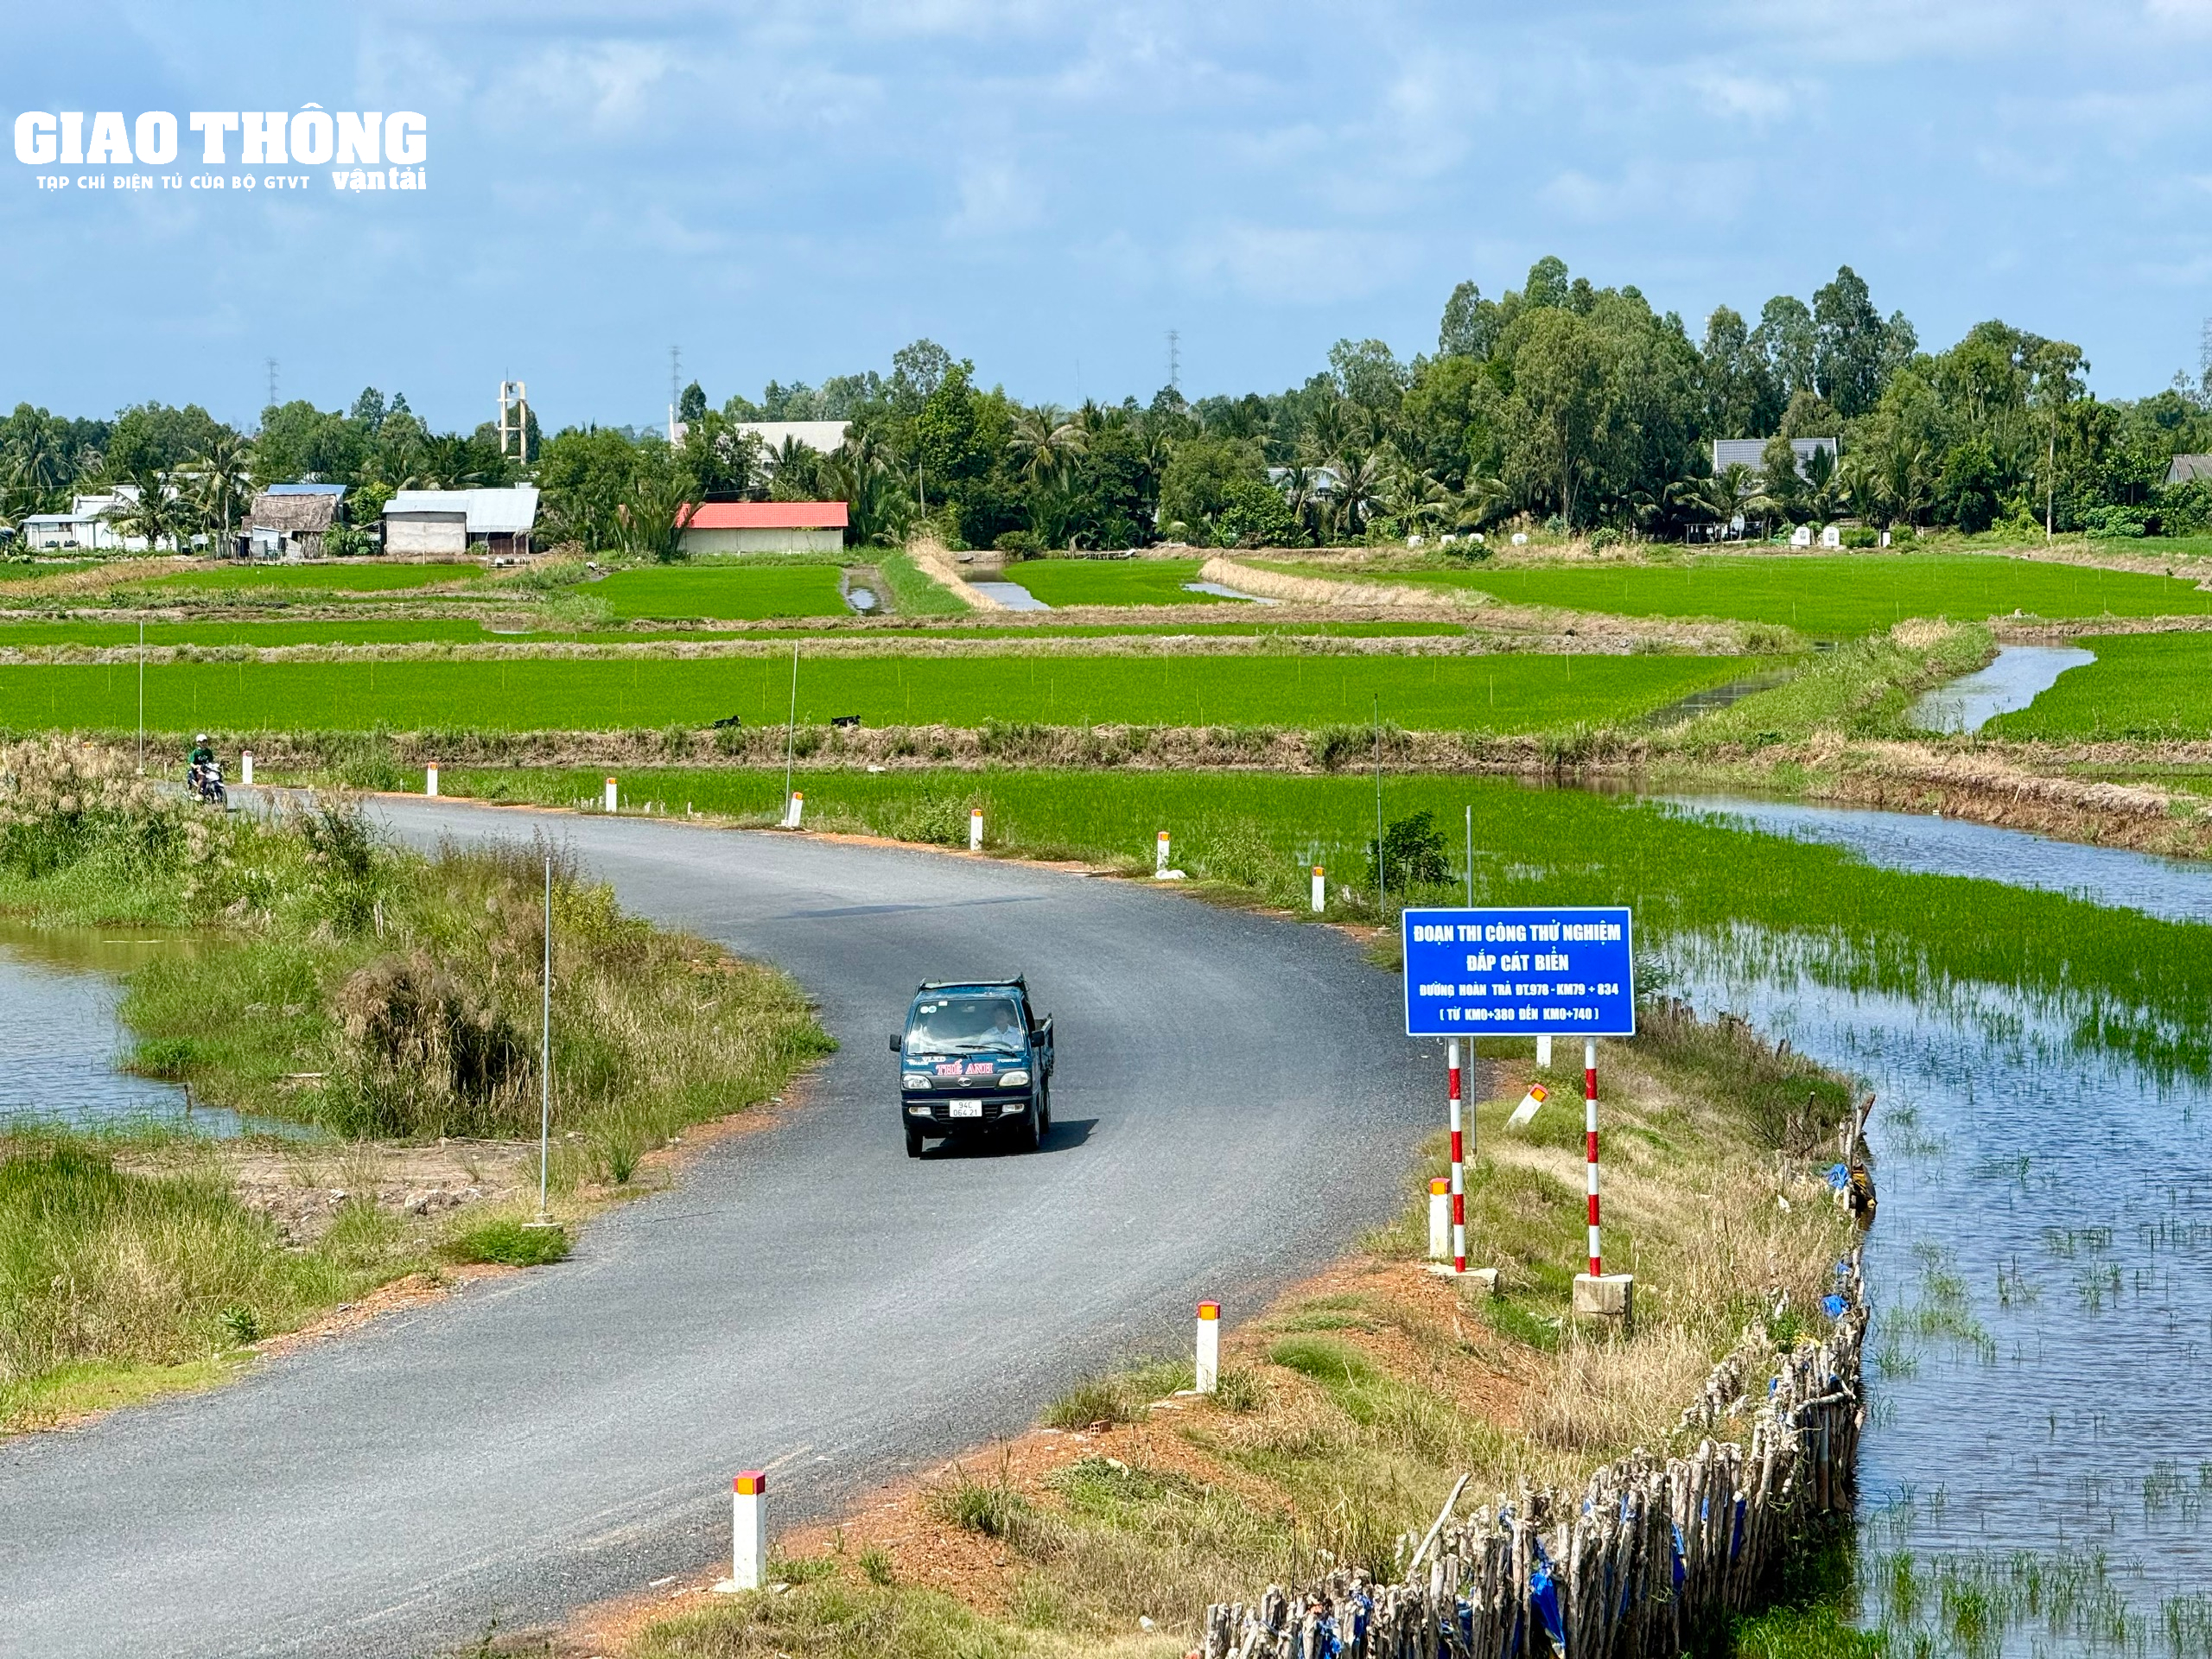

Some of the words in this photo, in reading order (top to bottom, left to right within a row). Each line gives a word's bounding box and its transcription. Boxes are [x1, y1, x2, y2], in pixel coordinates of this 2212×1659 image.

[1414, 925, 1454, 946] ĐOẠN
[1457, 925, 1483, 942] THI
[1484, 921, 1527, 943] CÔNG
[1529, 918, 1561, 942] THỬ
[1562, 919, 1621, 946] NGHIỆM
[1466, 948, 1497, 972] ĐẮP
[1500, 950, 1530, 972] CÁT
[1535, 945, 1569, 971] BIỂN
[1419, 981, 1455, 996] ĐƯỜNG
[1459, 981, 1487, 996] HOÀN
[1491, 980, 1513, 996] TRẢ
[1556, 983, 1586, 995] KM79
[1597, 982, 1619, 995] 834
[1518, 1003, 1539, 1020] ĐẾN
[936, 1058, 963, 1076] THẾ
[965, 1062, 994, 1075] ANH
